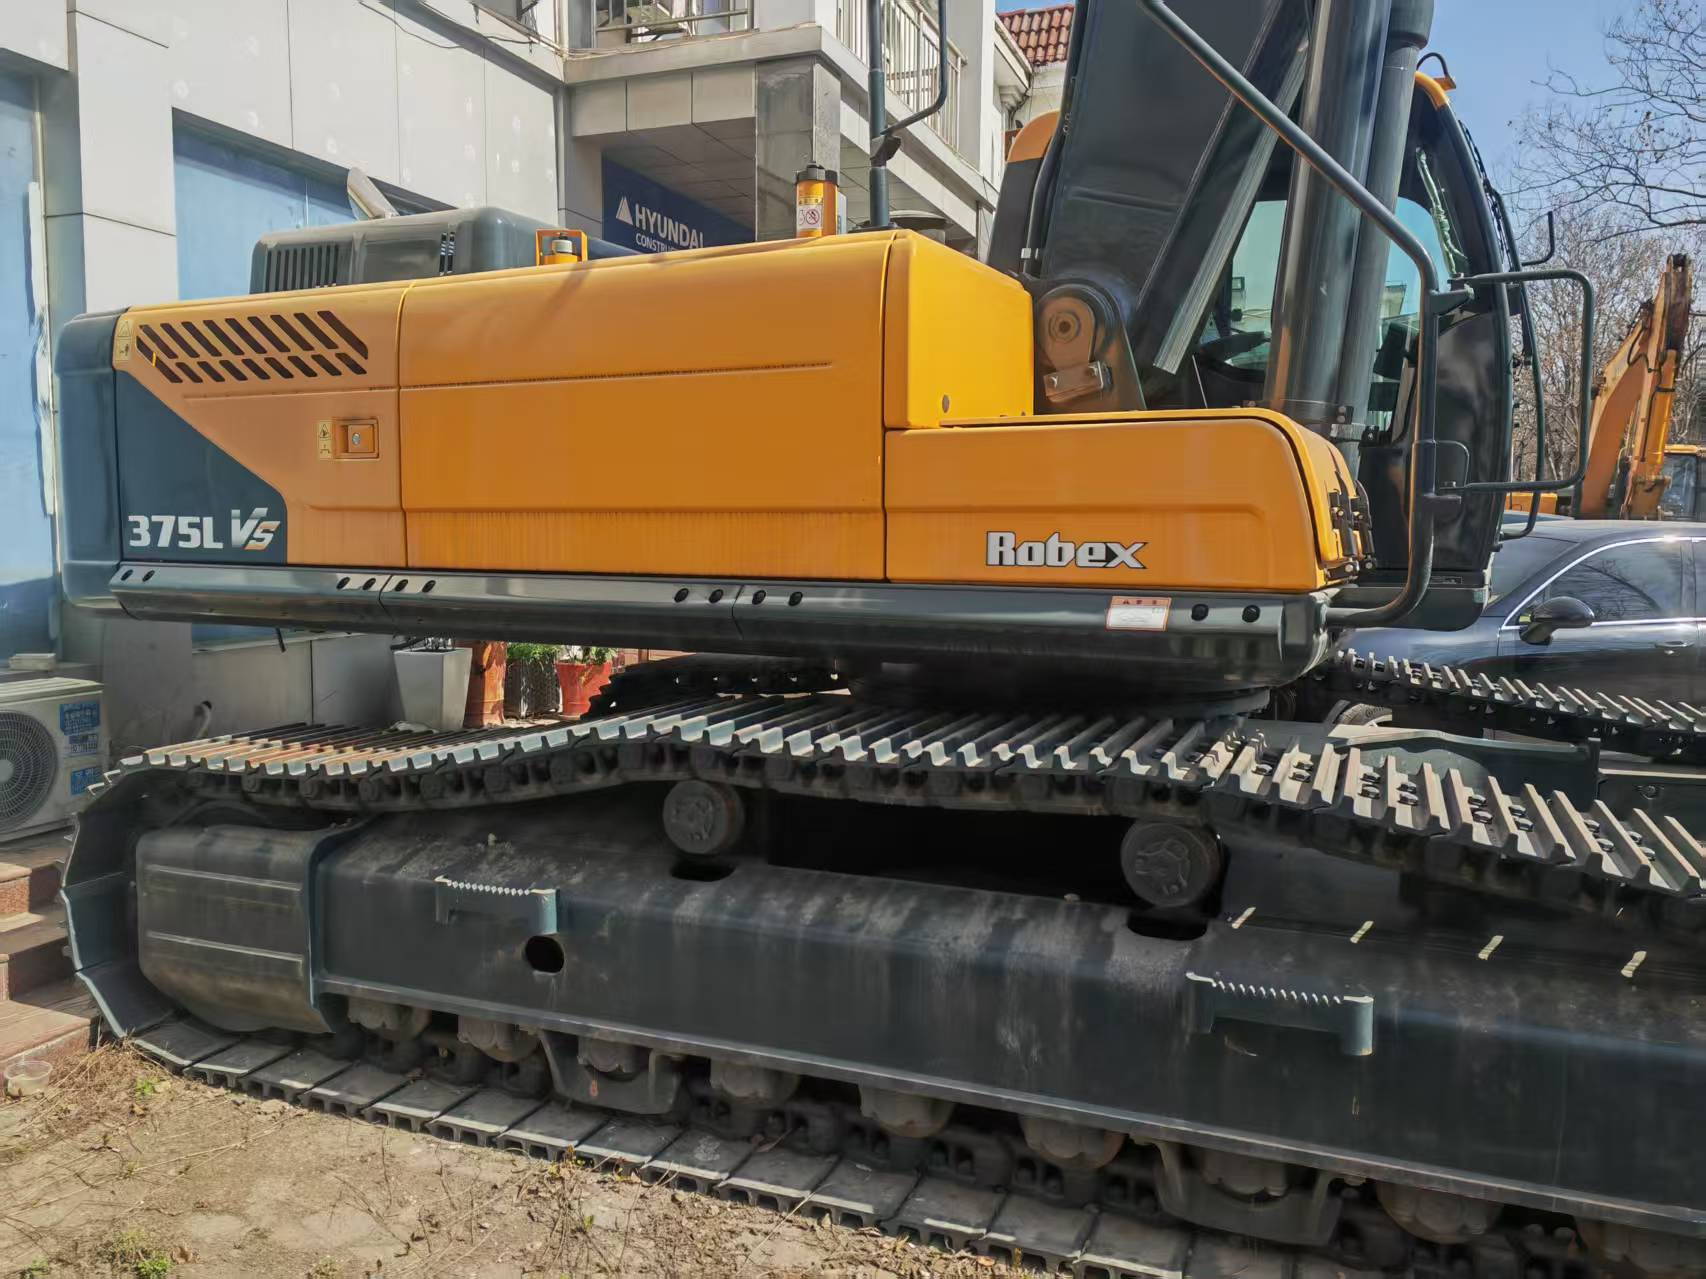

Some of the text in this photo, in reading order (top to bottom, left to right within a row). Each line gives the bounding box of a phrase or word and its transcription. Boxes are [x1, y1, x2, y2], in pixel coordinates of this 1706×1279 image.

[635, 203, 704, 249] HYUNDAI
[128, 515, 224, 549] 375L
[986, 531, 1148, 569] Robex
